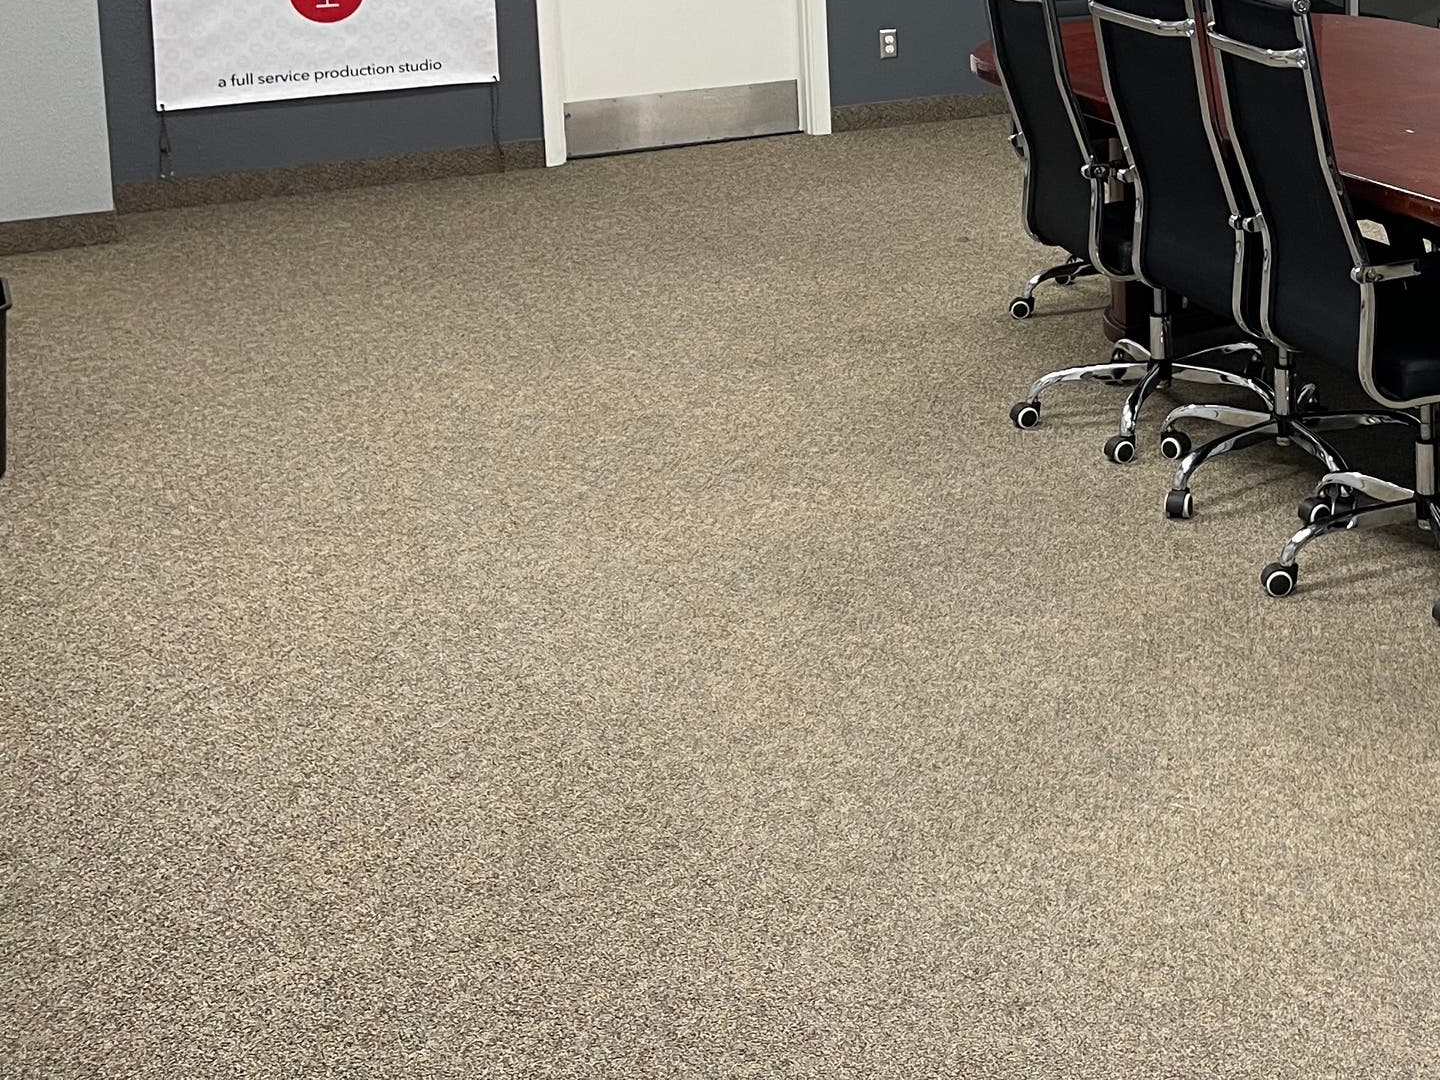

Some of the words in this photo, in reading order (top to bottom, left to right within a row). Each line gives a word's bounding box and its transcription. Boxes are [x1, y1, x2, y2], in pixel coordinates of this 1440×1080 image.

[218, 78, 227, 88] a
[231, 72, 254, 87] full
[258, 69, 310, 85] service
[314, 63, 394, 83] production
[398, 59, 442, 72] studio
